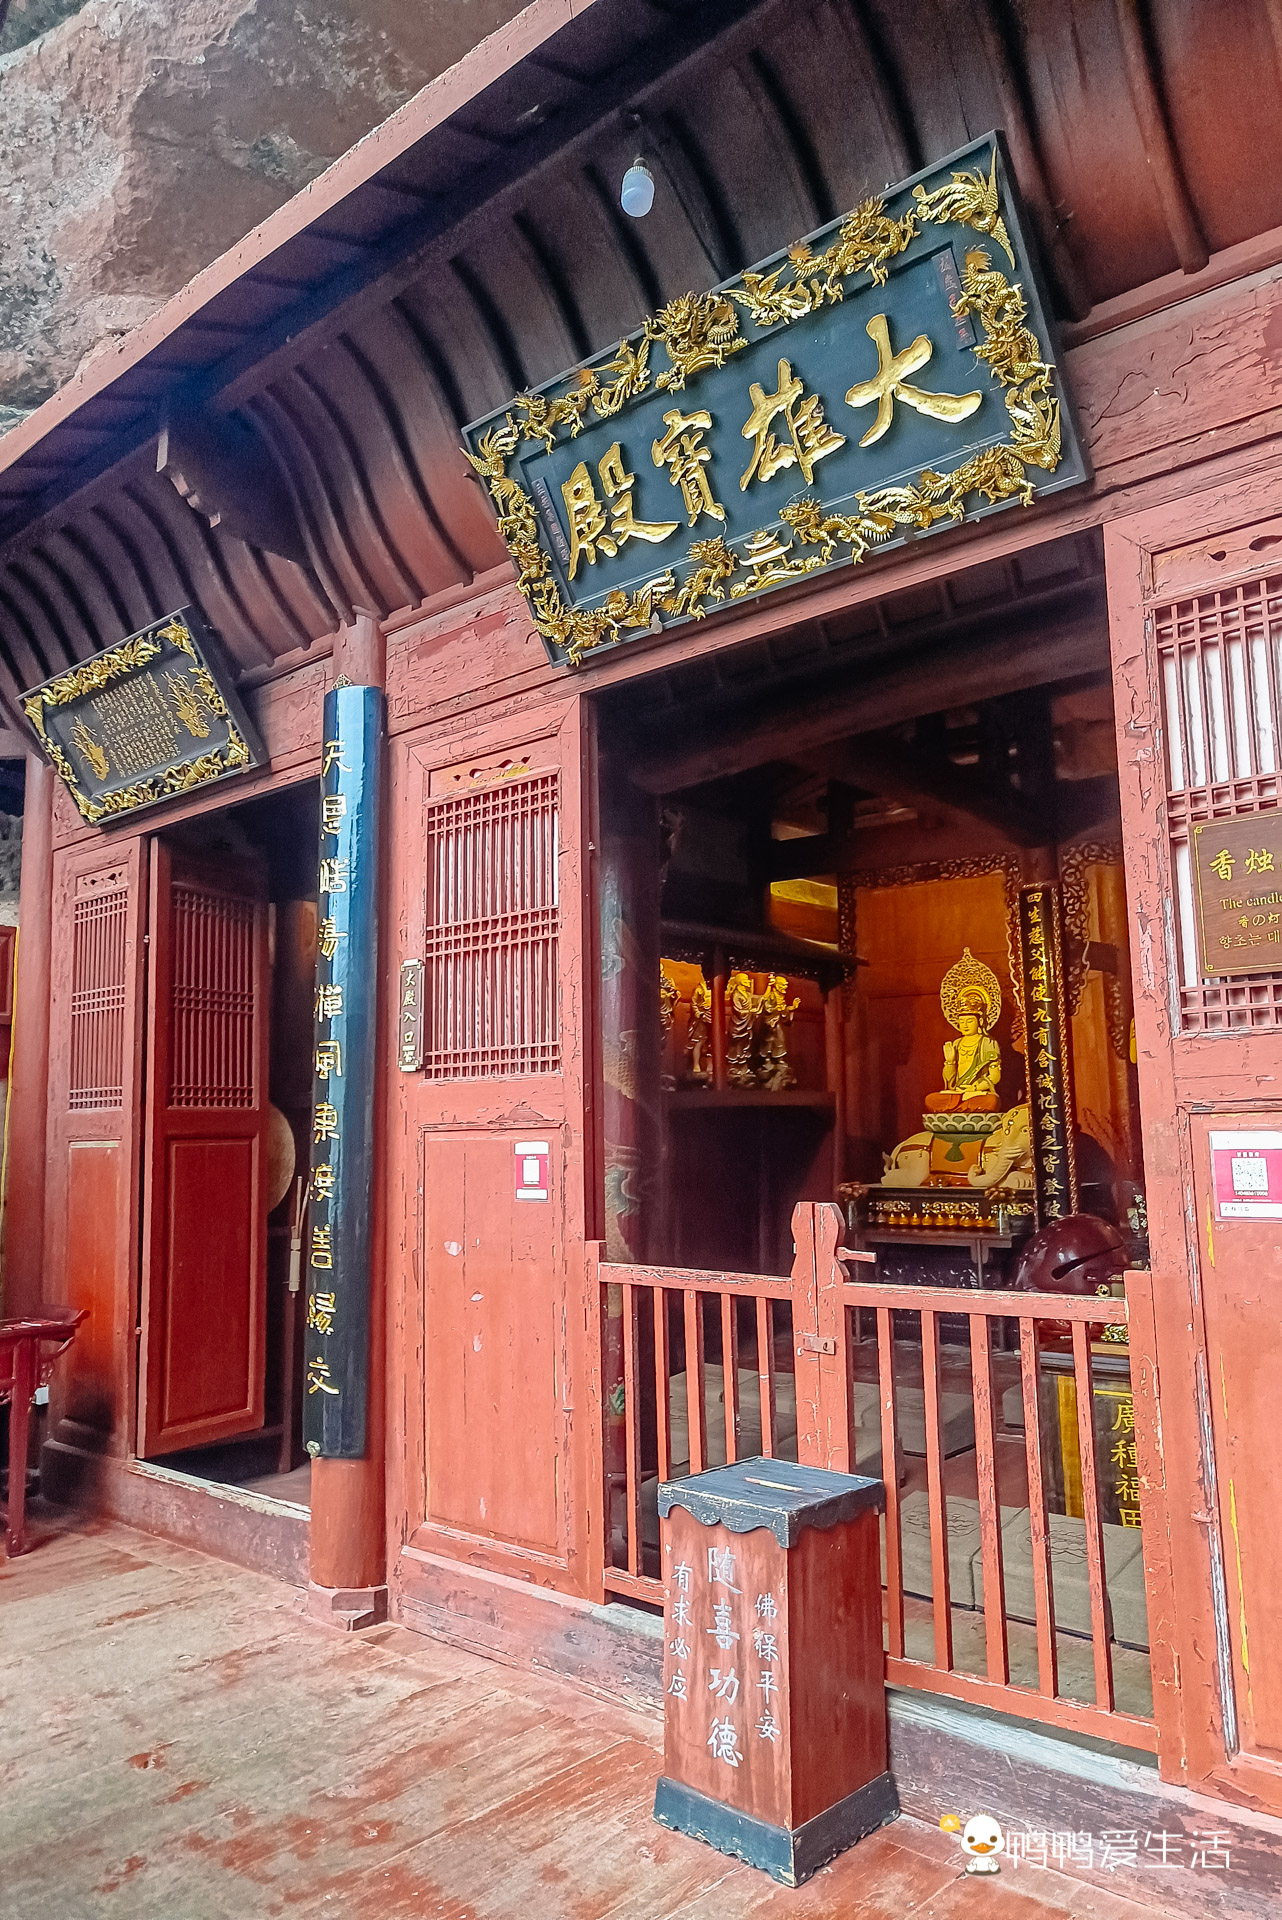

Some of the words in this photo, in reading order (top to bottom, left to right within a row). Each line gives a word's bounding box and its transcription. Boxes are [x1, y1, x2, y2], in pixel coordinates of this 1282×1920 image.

[1209, 848, 1282, 881] 香烛
[1219, 898, 1243, 910] The
[1218, 932, 1262, 949] 향초는
[402, 970, 417, 1043] 大殿入口
[667, 1559, 693, 1702] 有求必应
